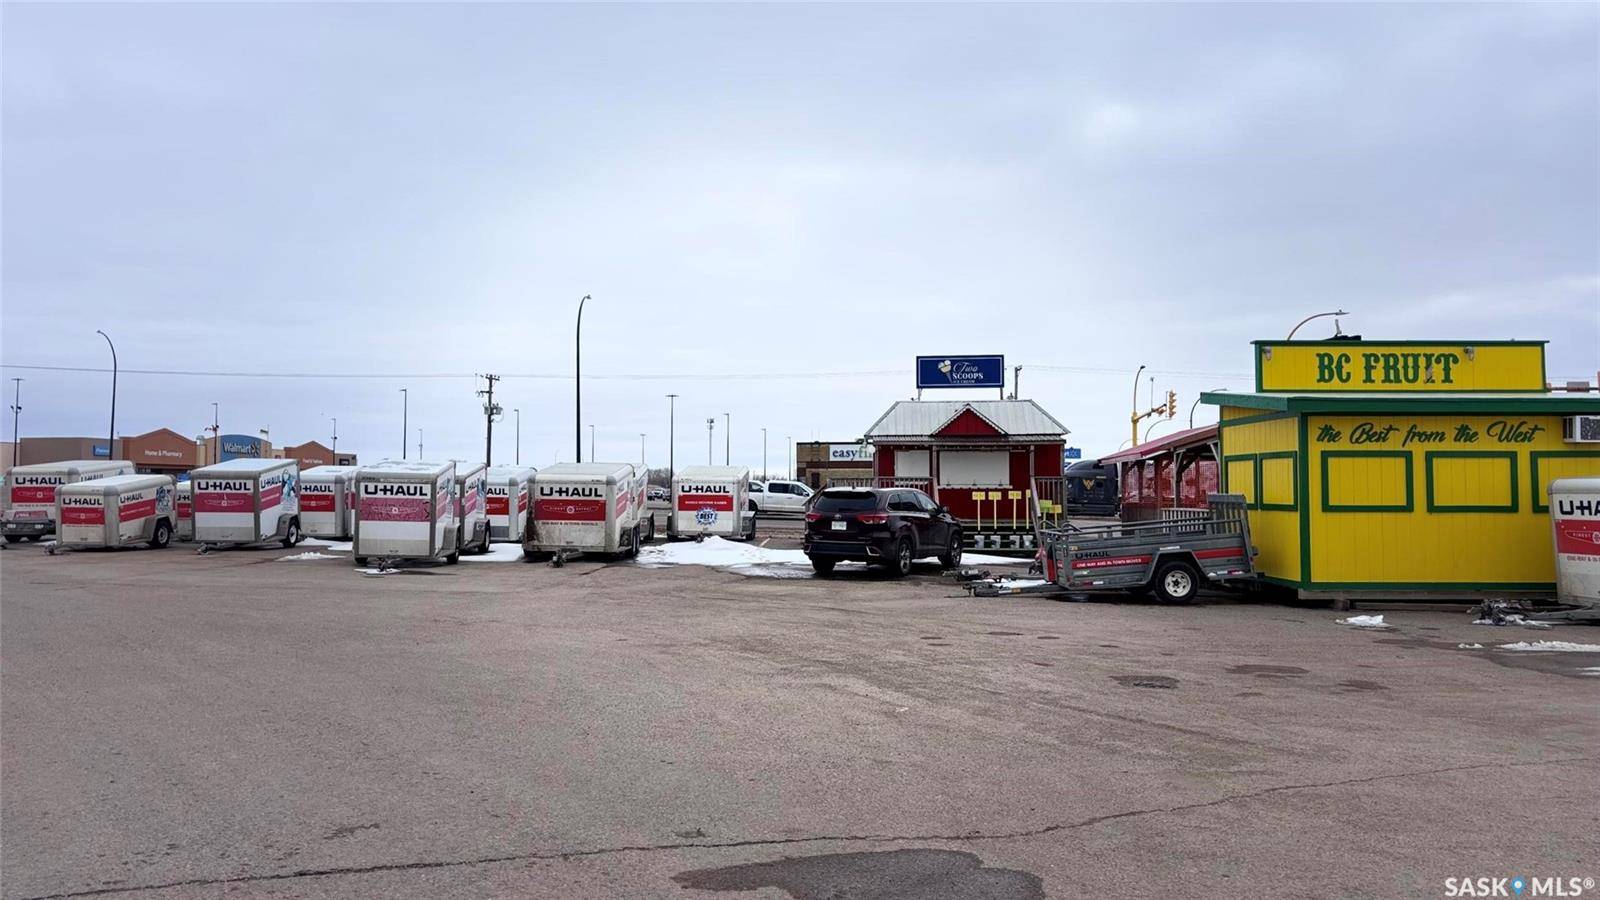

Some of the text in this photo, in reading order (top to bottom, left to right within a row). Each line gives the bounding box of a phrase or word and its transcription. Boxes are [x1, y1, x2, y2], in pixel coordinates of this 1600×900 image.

[953, 361, 978, 373] Two
[1316, 352, 1459, 385] BC FRUIT
[952, 372, 984, 380] SCOOPS
[1317, 420, 1546, 448] the Best from the West
[224, 441, 250, 455] Walmart
[15, 477, 66, 485] U-HAUL
[197, 481, 251, 491] U-HAUL
[261, 474, 282, 490] U-HAUL
[364, 484, 428, 497] U-HAUL
[487, 488, 508, 496] AUL
[540, 486, 603, 497] U-HAUL
[681, 485, 730, 493] U-HAUL
[120, 493, 144, 504] U-HAUL
[1075, 551, 1110, 559] U-HAUL
